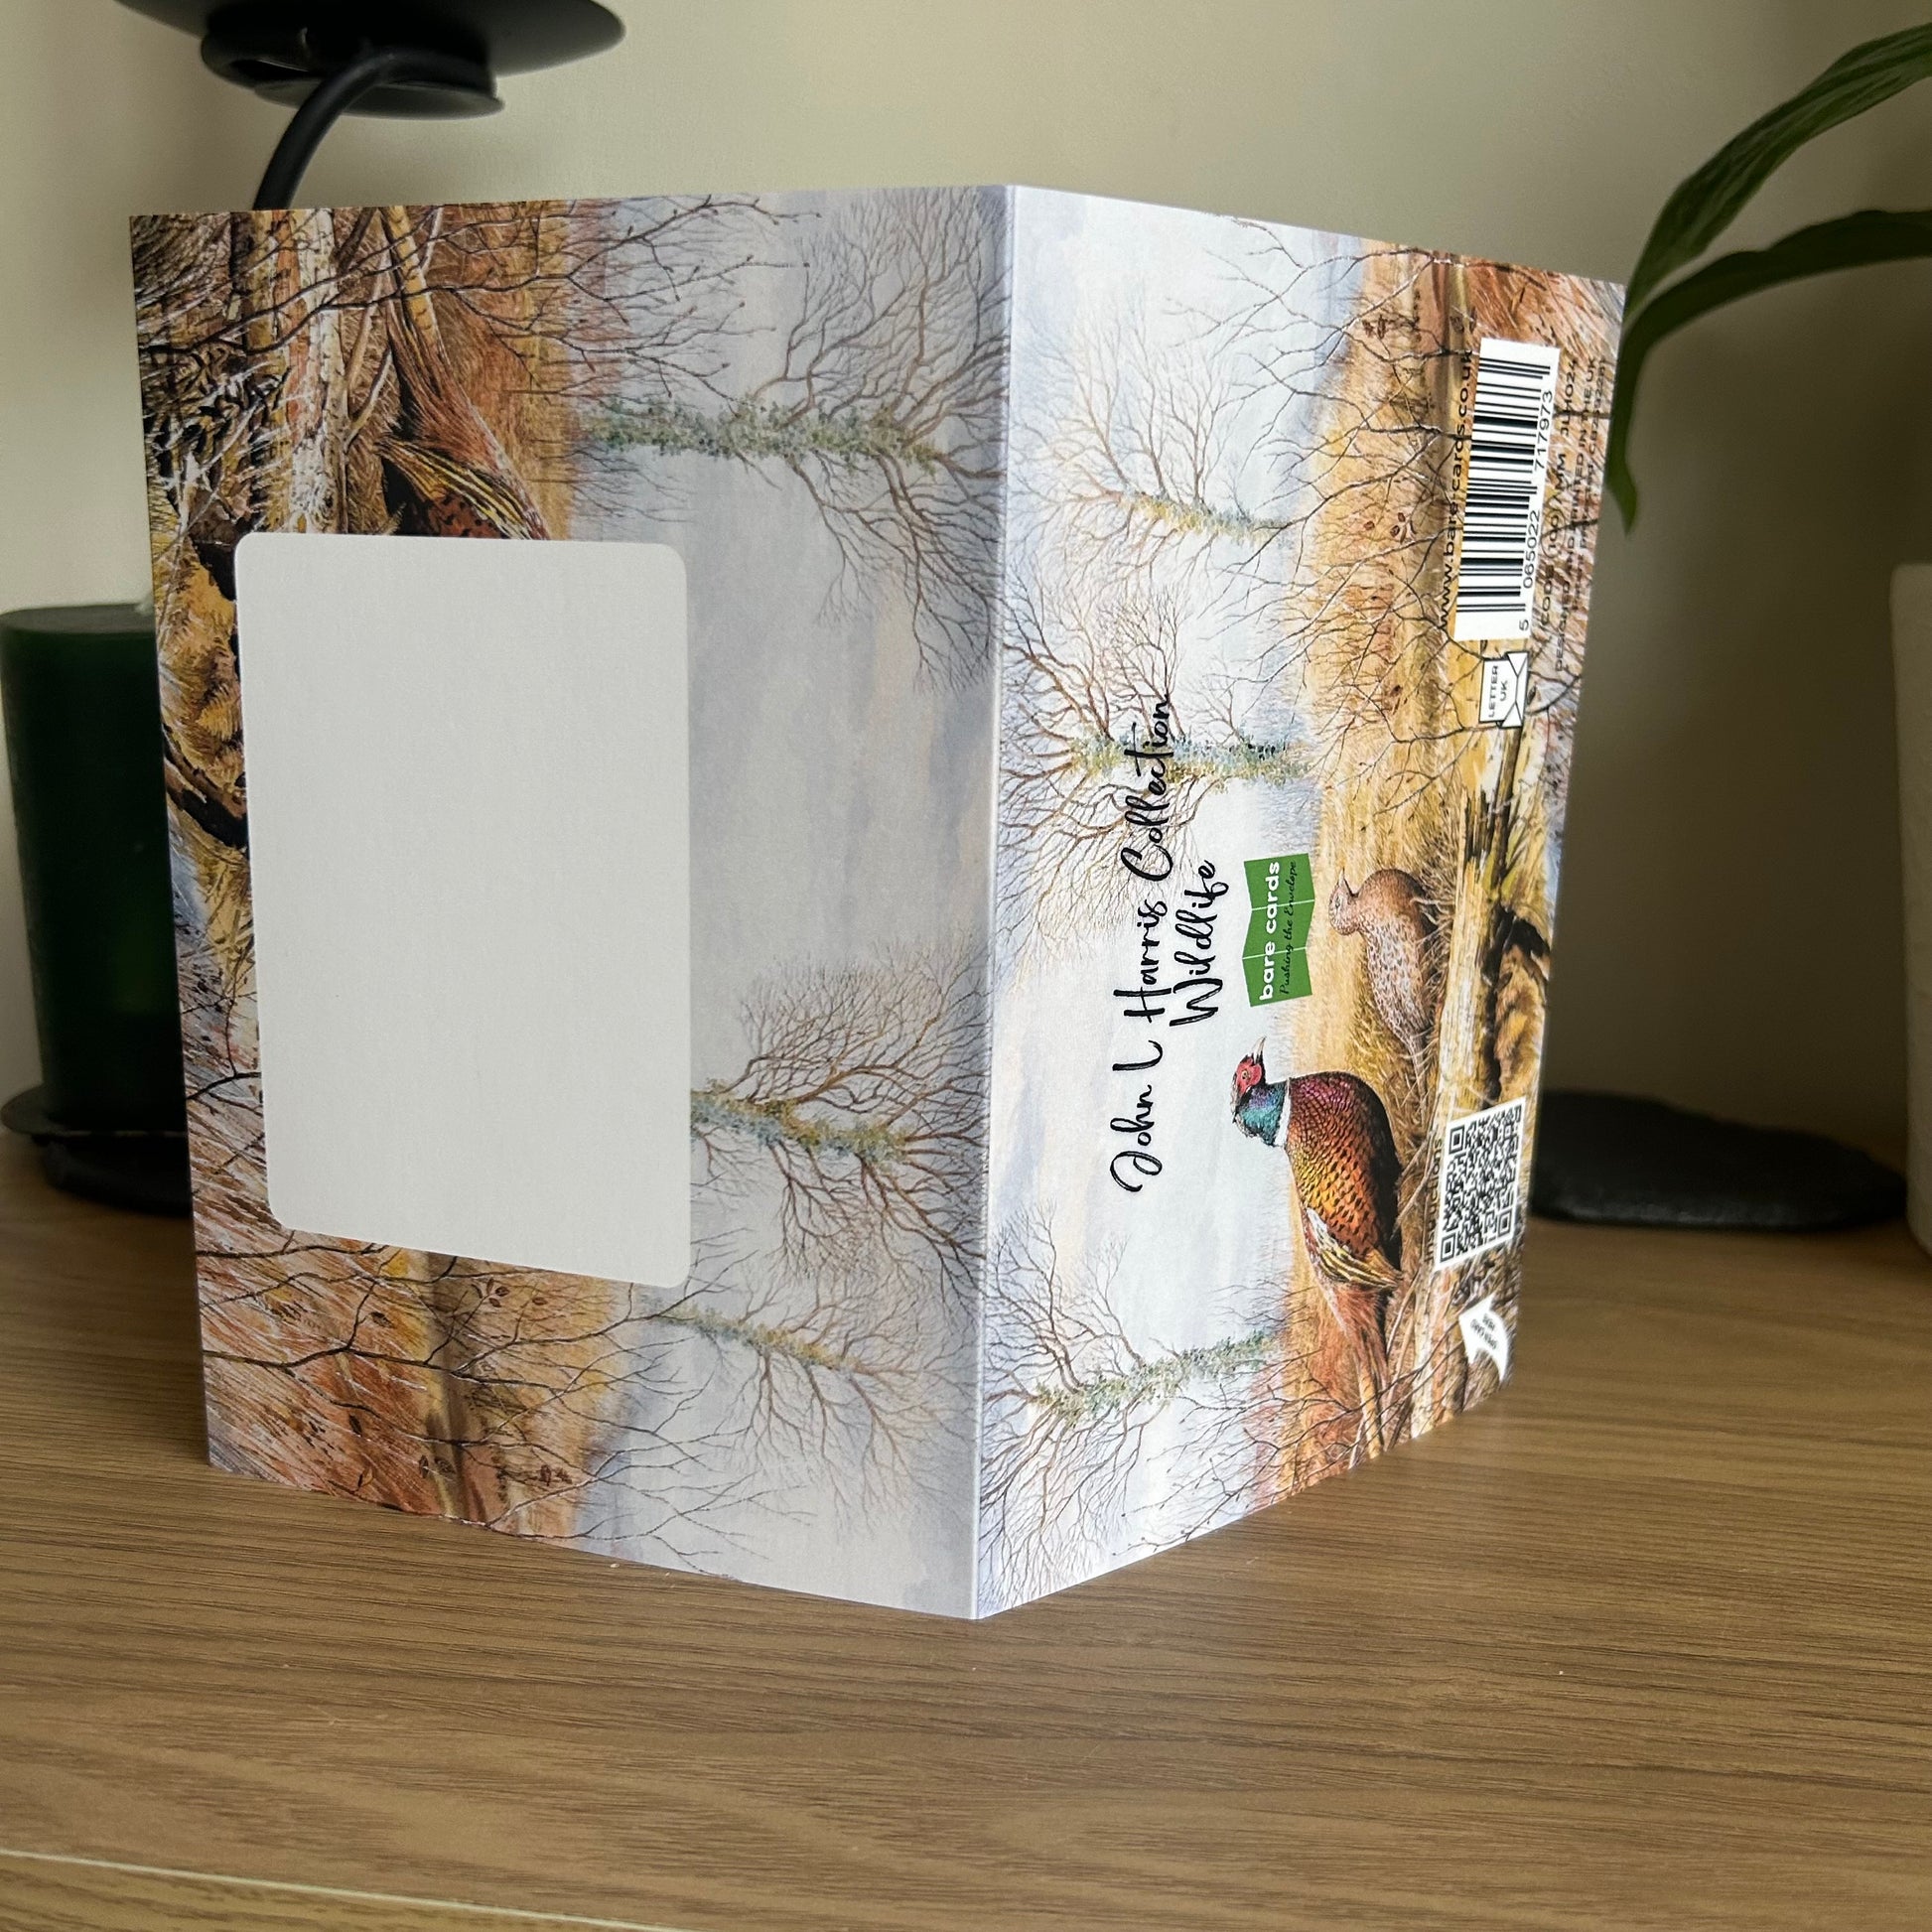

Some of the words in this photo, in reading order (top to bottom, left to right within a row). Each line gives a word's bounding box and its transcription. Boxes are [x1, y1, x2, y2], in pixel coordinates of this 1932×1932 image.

[1535, 390, 1553, 472] 717973
[1555, 581, 1571, 672] DESIGNED
[1579, 429, 1587, 448] IN
[1586, 357, 1596, 383] UK
[1523, 510, 1540, 589] 065022
[1519, 619, 1529, 631] 5
[1541, 564, 1554, 625] CODE
[1488, 665, 1499, 718] LETTER
[1500, 680, 1508, 702] UK
[1121, 693, 1174, 882] Collection
[1266, 861, 1281, 934] cards
[1284, 861, 1298, 916] Envelope
[1170, 860, 1229, 1028] Wildlife
[1284, 921, 1294, 940] the
[1113, 899, 1173, 1024] Harris
[1259, 941, 1277, 1001] bare
[1279, 944, 1295, 995] Pushing
[1112, 1039, 1164, 1071] L
[1110, 1084, 1163, 1192] John
